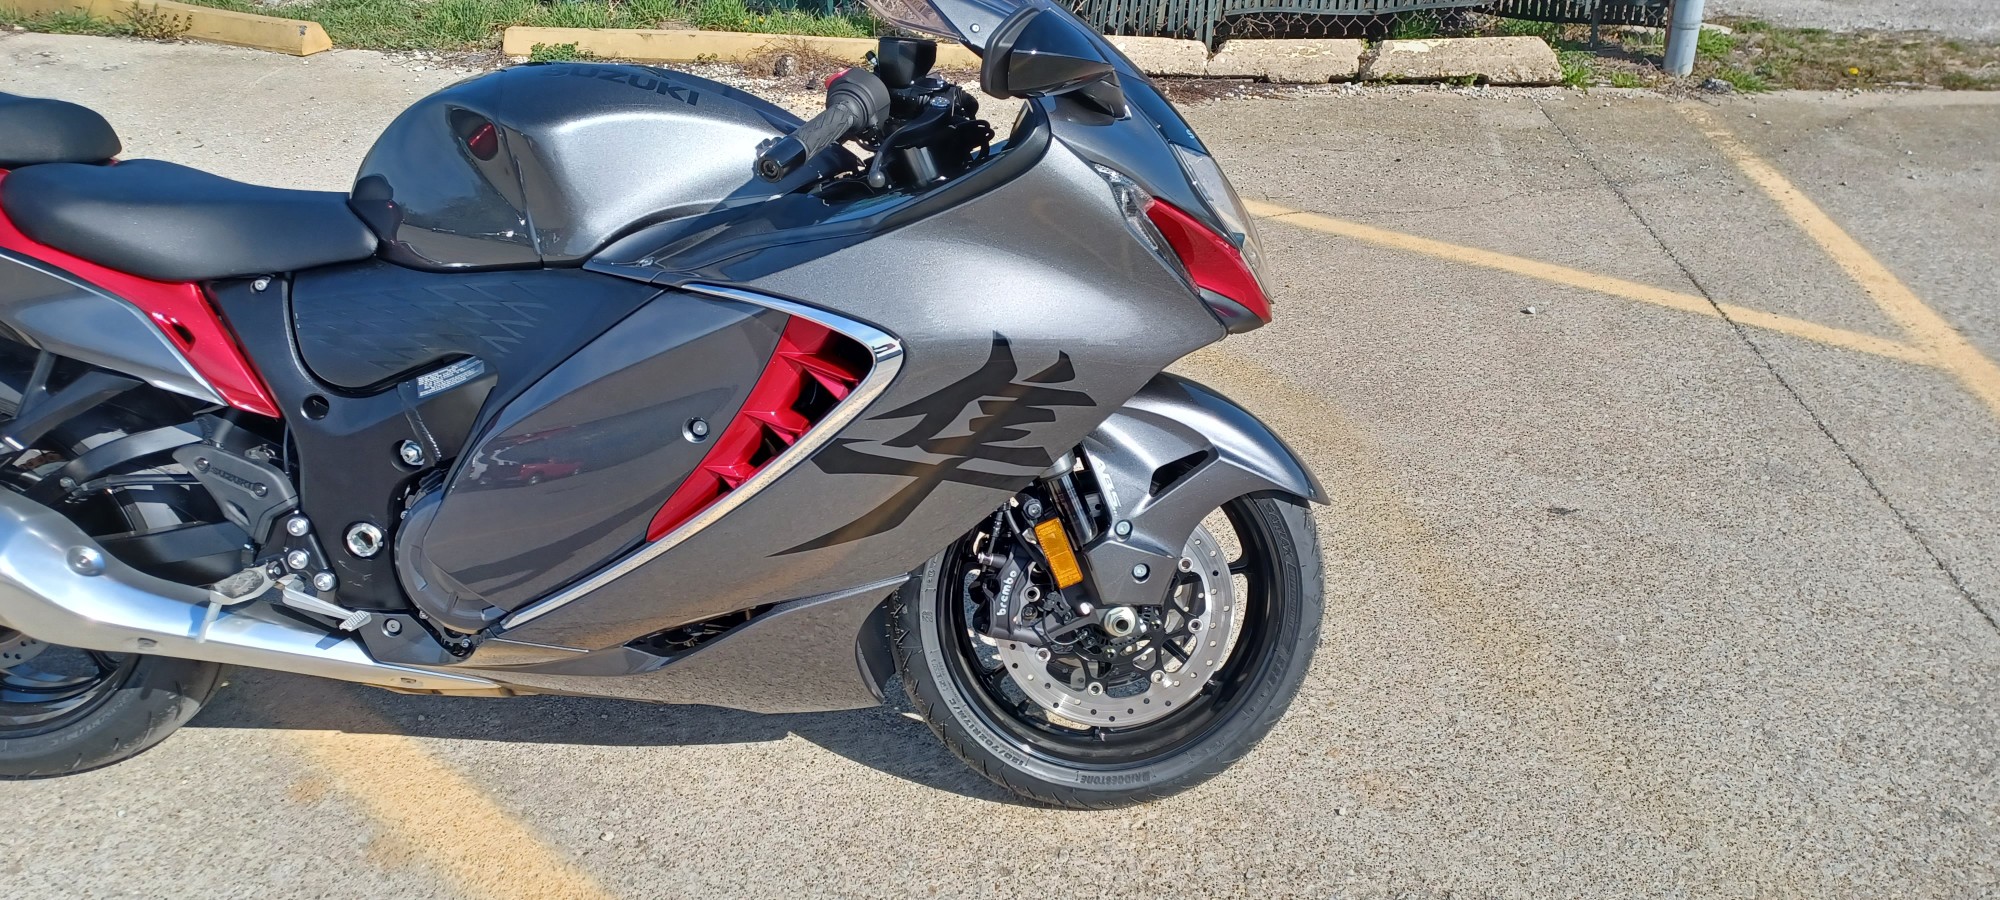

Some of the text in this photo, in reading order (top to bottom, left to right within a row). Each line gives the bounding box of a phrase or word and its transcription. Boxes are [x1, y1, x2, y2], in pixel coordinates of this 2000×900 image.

[544, 66, 699, 106] SUZUKI
[764, 330, 1097, 558] 隼
[210, 466, 255, 491] SUZUKI
[1088, 454, 1122, 510] ABS
[996, 570, 1017, 616] brembo
